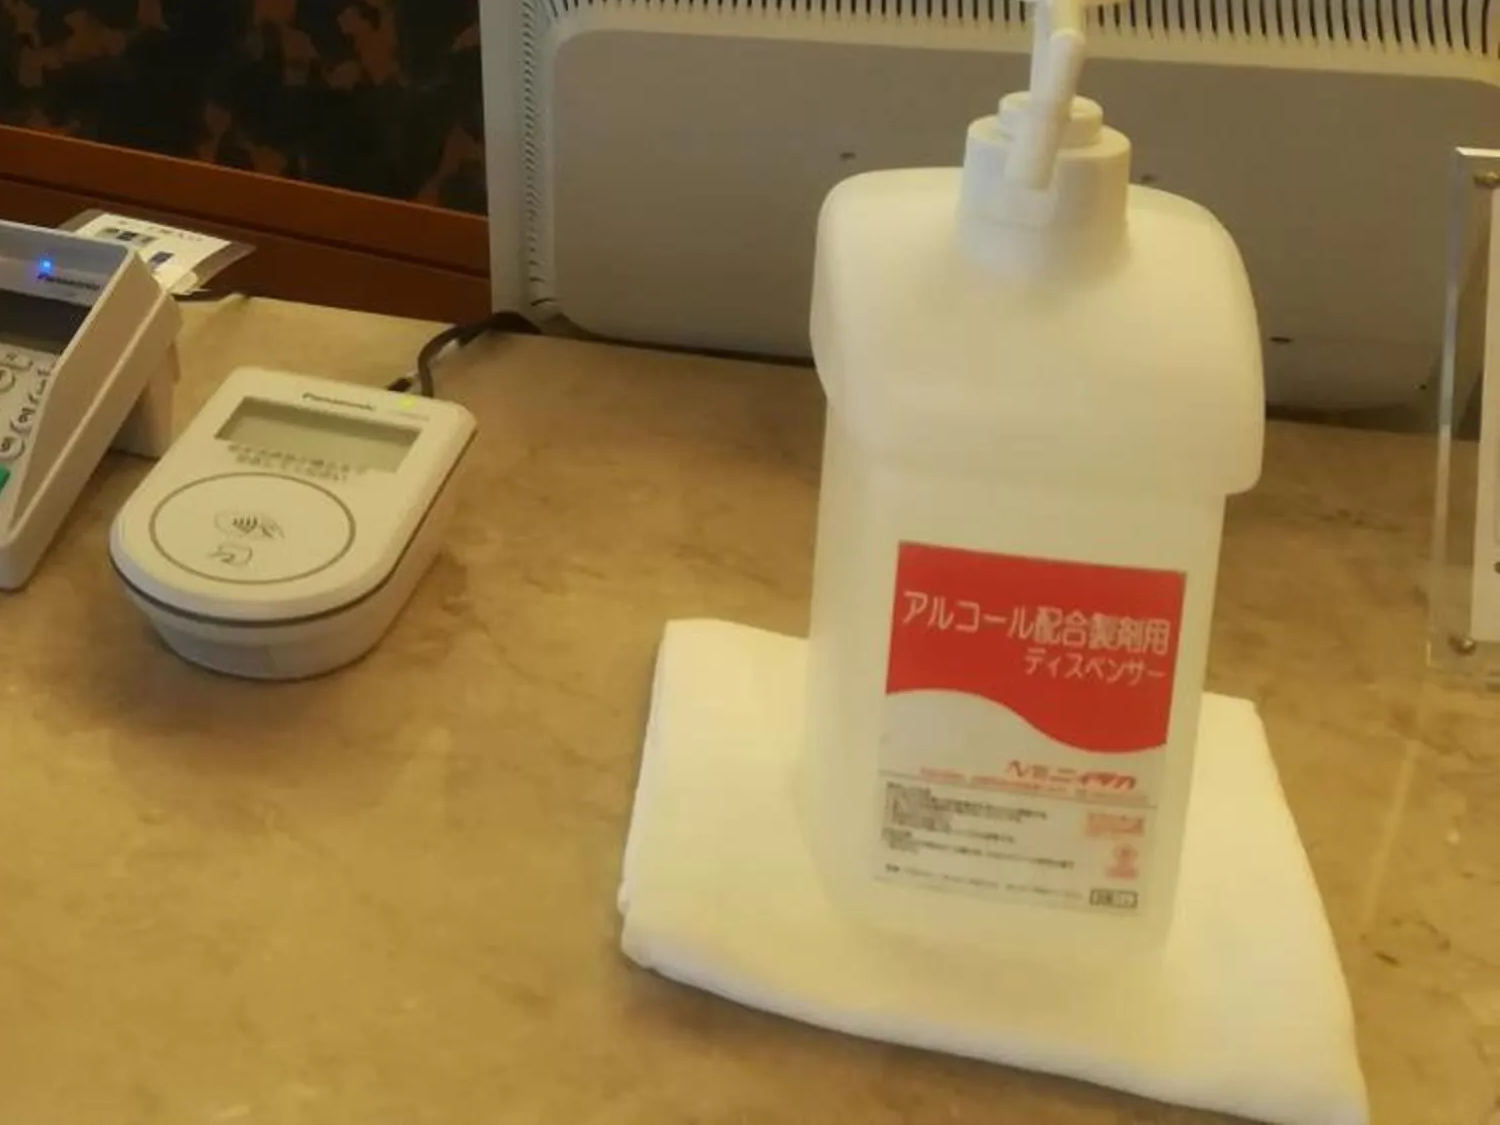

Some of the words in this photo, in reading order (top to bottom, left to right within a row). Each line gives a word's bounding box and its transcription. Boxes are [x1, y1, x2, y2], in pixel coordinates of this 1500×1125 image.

[901, 590, 1172, 655] アルコール配合製剤用
